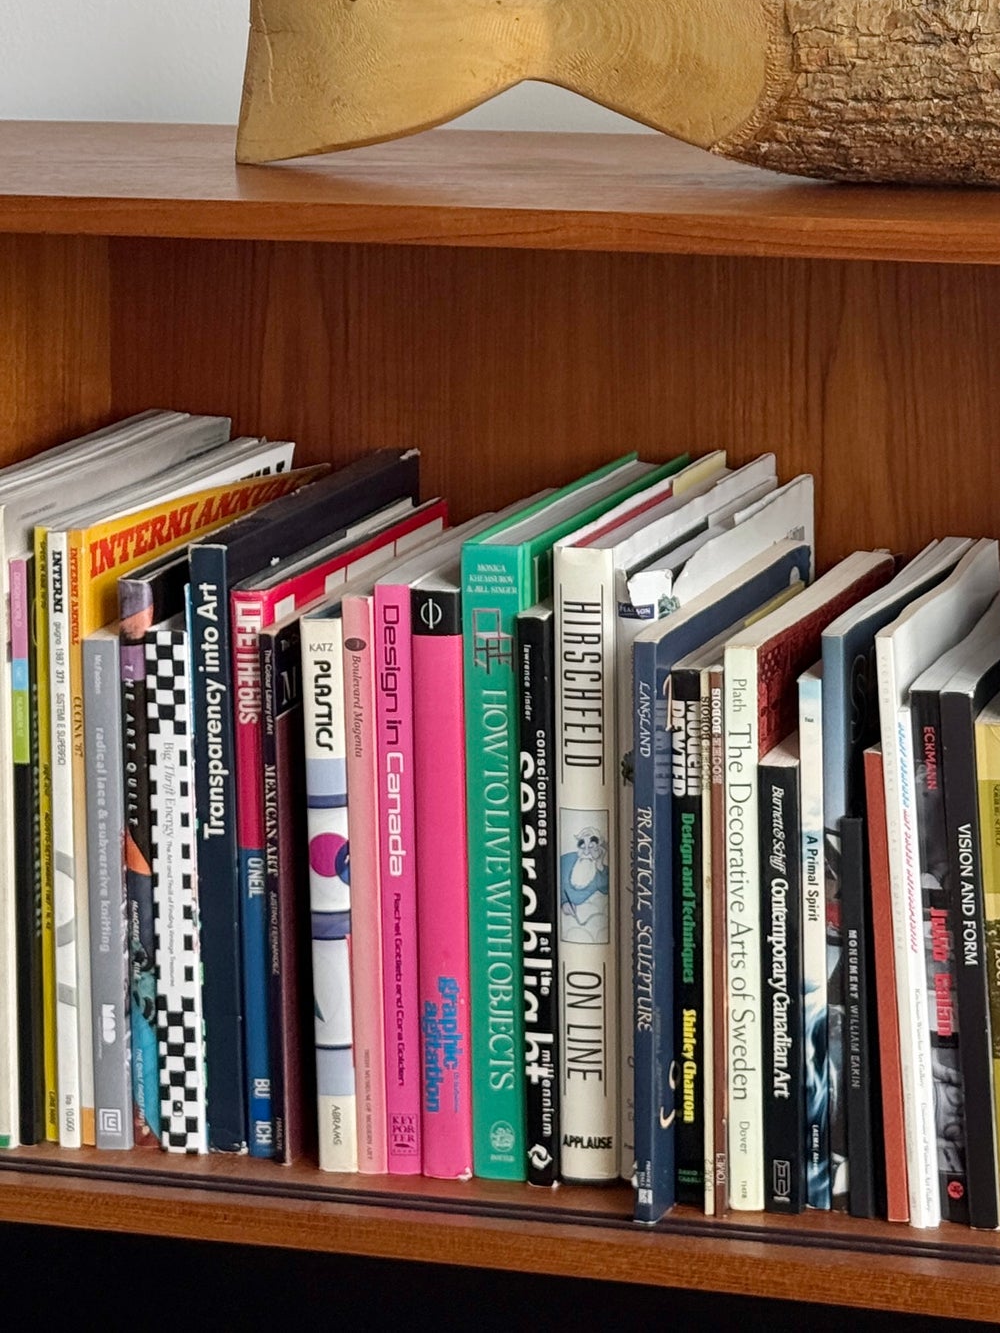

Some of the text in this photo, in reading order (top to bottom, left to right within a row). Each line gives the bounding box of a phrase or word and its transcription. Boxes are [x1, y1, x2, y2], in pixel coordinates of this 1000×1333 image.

[52, 549, 65, 685] INTERNI 371
[236, 602, 262, 647] LIFE
[309, 642, 334, 653] KATZ
[196, 582, 227, 840] Transparency into Art
[262, 649, 274, 715] The Colour Library
[312, 659, 334, 751] PLASTICS
[350, 654, 366, 758] Boulevard Magenta
[522, 644, 534, 722] lawrence rinder
[124, 664, 140, 828] THE ART QUILT
[160, 741, 177, 839] Big Thrift Energy
[379, 604, 407, 877] Design in Canada
[535, 729, 549, 847] consciousness
[922, 725, 938, 791] ECKMANN
[94, 727, 113, 952] radical lace subversive knitting
[246, 856, 265, 898] O'NEIL
[263, 763, 281, 877] MEXICAN ART
[561, 600, 604, 1083] HIRSCHFELD ON LINE
[636, 680, 655, 1033] LANGLAND PRACTICAL SCULPTURE
[480, 688, 517, 1091] HOW TO LIVE WITH OBJECTS
[679, 812, 697, 984] Design and Techniques
[727, 677, 757, 1102] Plath The Decorative Arts of Sweden
[804, 835, 821, 922] A Primal Spirit
[957, 822, 979, 966] VISION AND FORM
[392, 892, 407, 1087] Rachel Gotlieb and Cora Golden
[539, 936, 553, 953] at
[766, 877, 793, 1099] Contemporary Canadian Art
[420, 999, 445, 1113] agitation
[436, 974, 465, 1070] graphic
[679, 1007, 698, 1123] Shirley Charron
[846, 928, 862, 1088] MONUMENT WILLIAM EAKIN
[330, 1104, 344, 1146] ABRAMS
[562, 1134, 614, 1149] APPLAUSE
[736, 1120, 750, 1155] Dover
